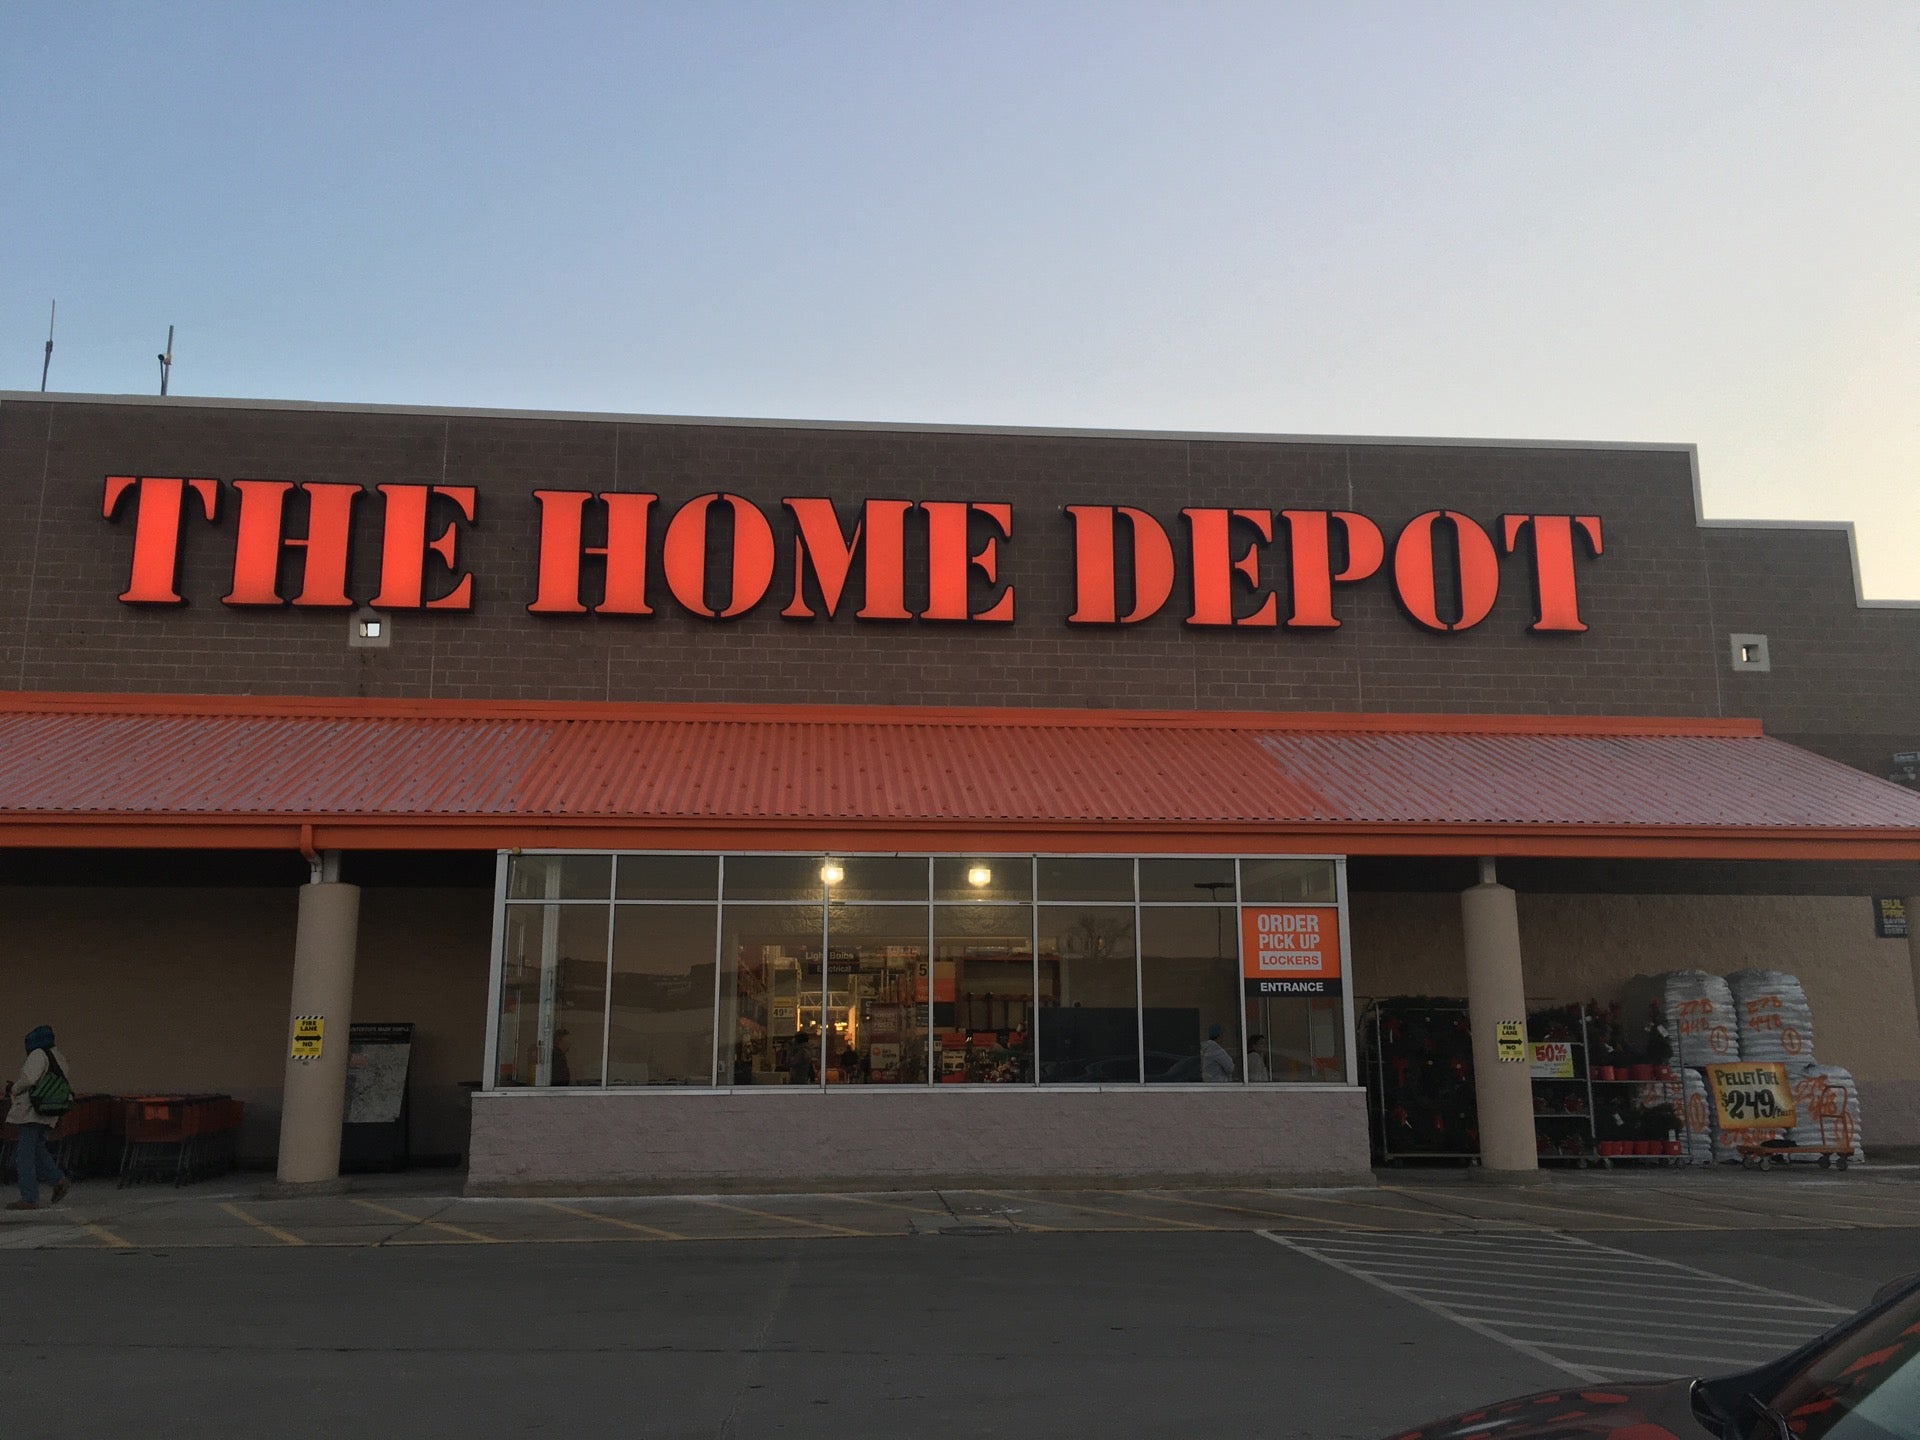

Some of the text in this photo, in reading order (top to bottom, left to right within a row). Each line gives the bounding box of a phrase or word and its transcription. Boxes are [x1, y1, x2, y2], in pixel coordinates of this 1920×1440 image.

[103, 475, 1604, 633] THE HOME DEPOT
[1880, 899, 1905, 909] BUL
[1881, 909, 1906, 918] PRIC
[1257, 914, 1319, 932] ORDER
[1259, 934, 1320, 949] PICK UP
[1262, 955, 1319, 965] LOCKERS
[816, 964, 852, 973] Ectrical
[1260, 982, 1324, 992] ENTRANCE
[1535, 1044, 1567, 1062] 50%
[1714, 1068, 1780, 1086] PELLET FUEL
